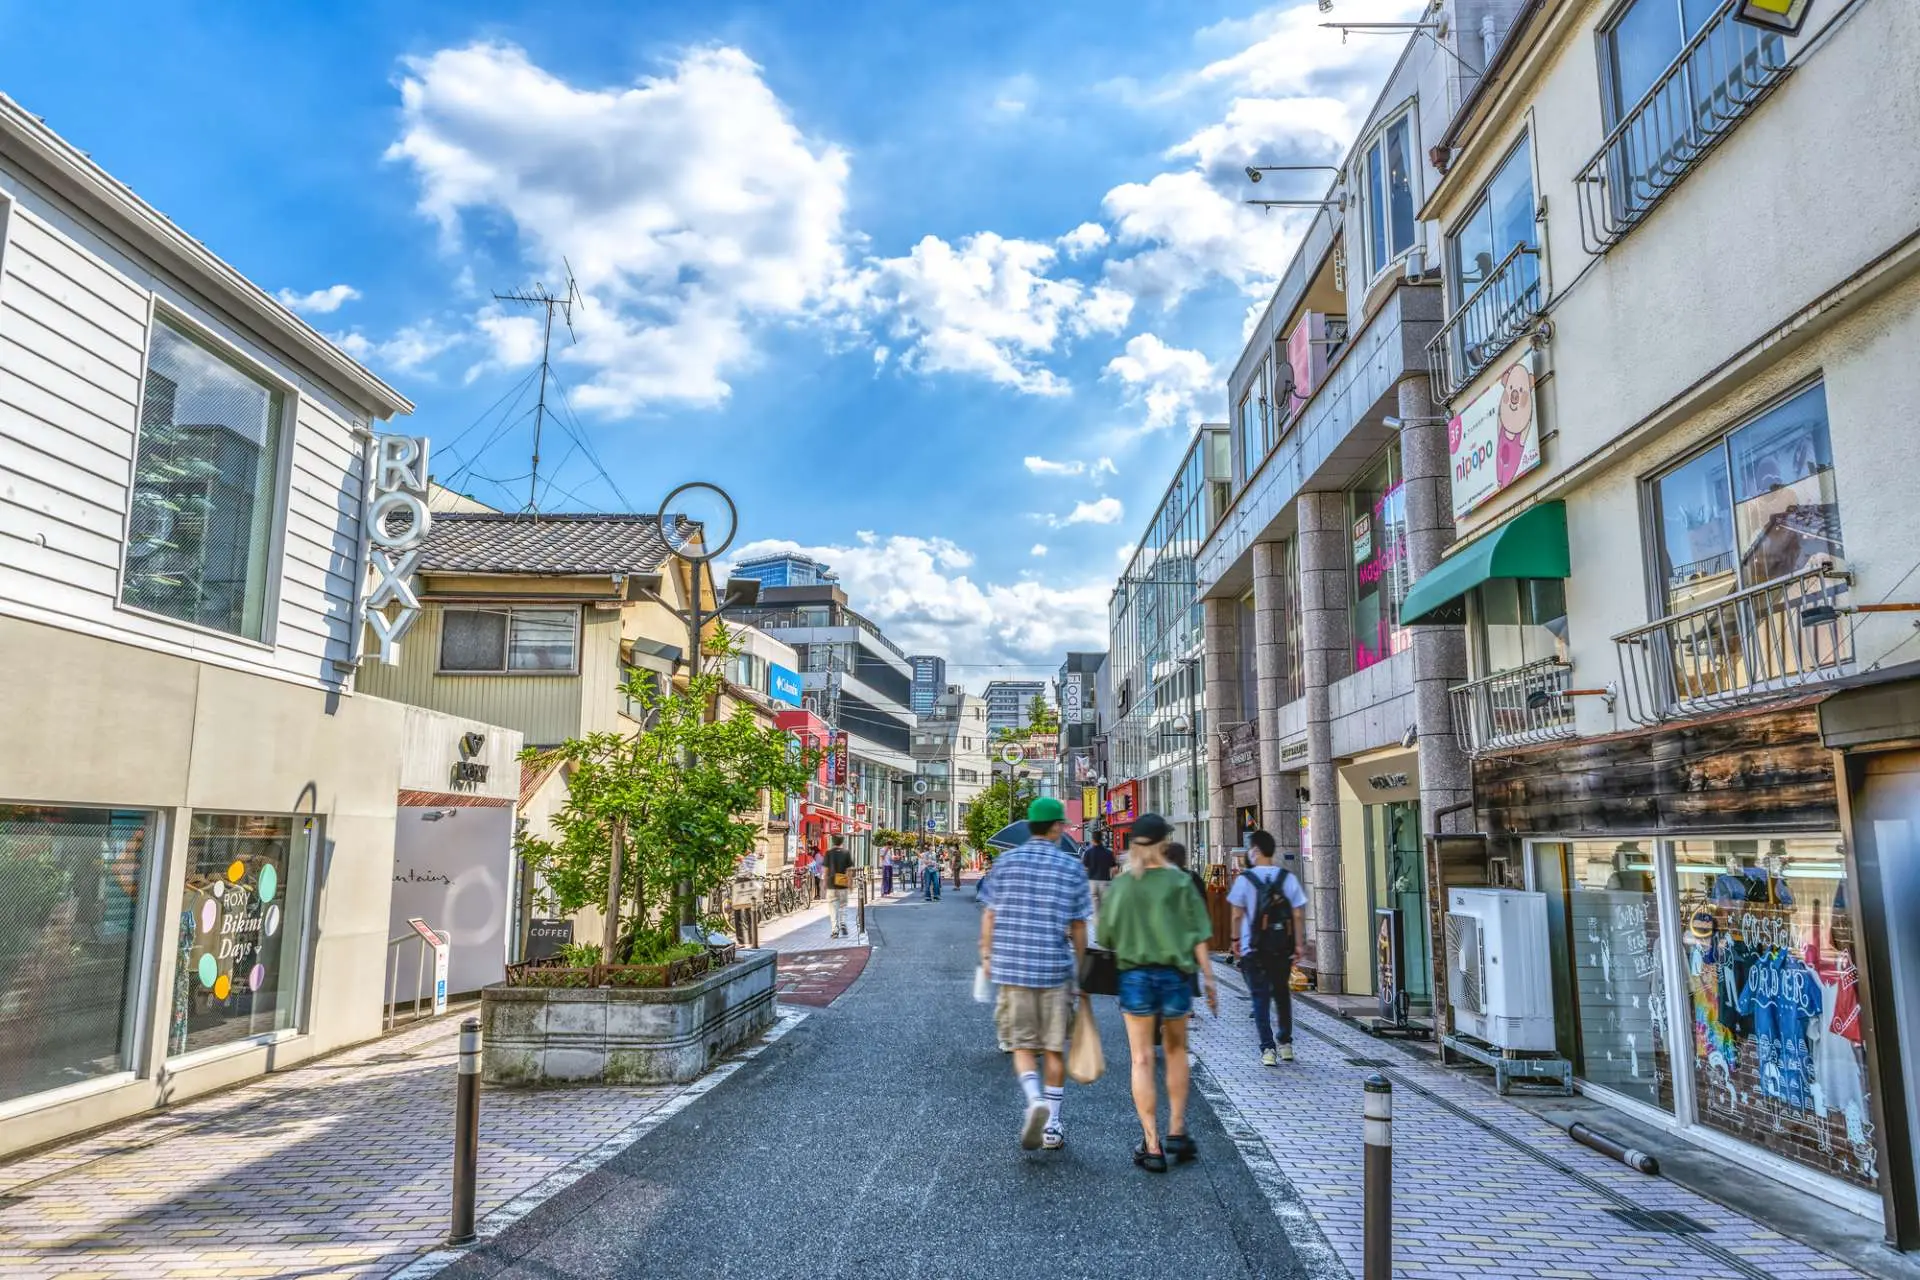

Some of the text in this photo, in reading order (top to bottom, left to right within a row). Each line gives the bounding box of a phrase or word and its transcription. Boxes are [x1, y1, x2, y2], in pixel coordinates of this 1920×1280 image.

[1456, 439, 1493, 483] nipopo
[366, 435, 431, 667] ROXY
[224, 892, 250, 908] ROXY
[221, 911, 264, 935] Bikini
[530, 928, 569, 938] COFFEE
[219, 938, 252, 964] Days
[1748, 961, 1809, 1008] ORDER
